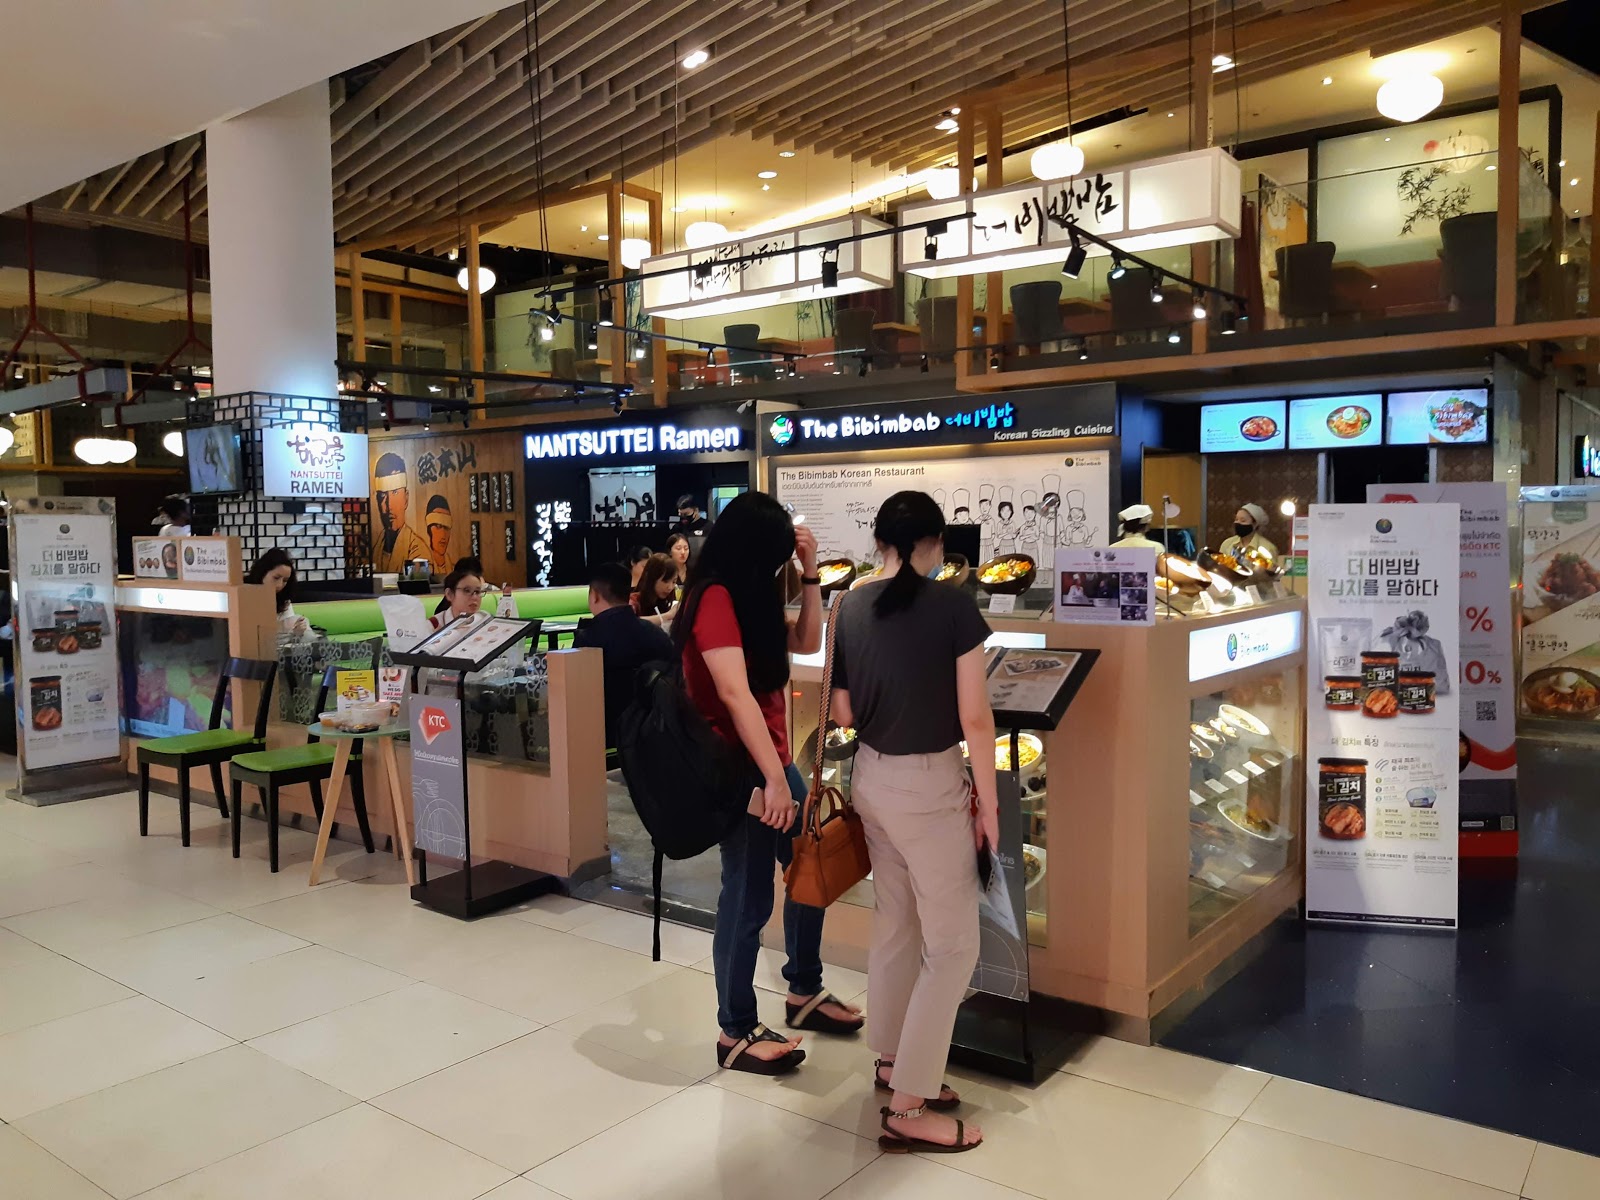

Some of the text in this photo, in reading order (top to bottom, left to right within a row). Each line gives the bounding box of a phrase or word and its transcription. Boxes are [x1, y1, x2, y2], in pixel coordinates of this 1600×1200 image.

[945, 401, 1014, 429] 더비빔밥
[800, 411, 941, 439] The Bibimbab
[993, 423, 1113, 441] Korean Sizzling Cuisine
[526, 425, 739, 459] NANTSUTTEI Ramen
[290, 470, 343, 480] NANTSUTTEI
[781, 466, 925, 481] The Bibimbab Korean Restaurant
[291, 480, 344, 494] RAMEN
[196, 547, 207, 555] The
[1483, 542, 1501, 550] KTC
[56, 548, 89, 561] 비빔밥
[197, 556, 227, 566] Bibimbab
[30, 562, 101, 576] 김치를 말하다
[1347, 558, 1420, 576] 더 비빔밥
[1327, 578, 1439, 597] 김치를 말하다
[428, 714, 446, 728] KTC
